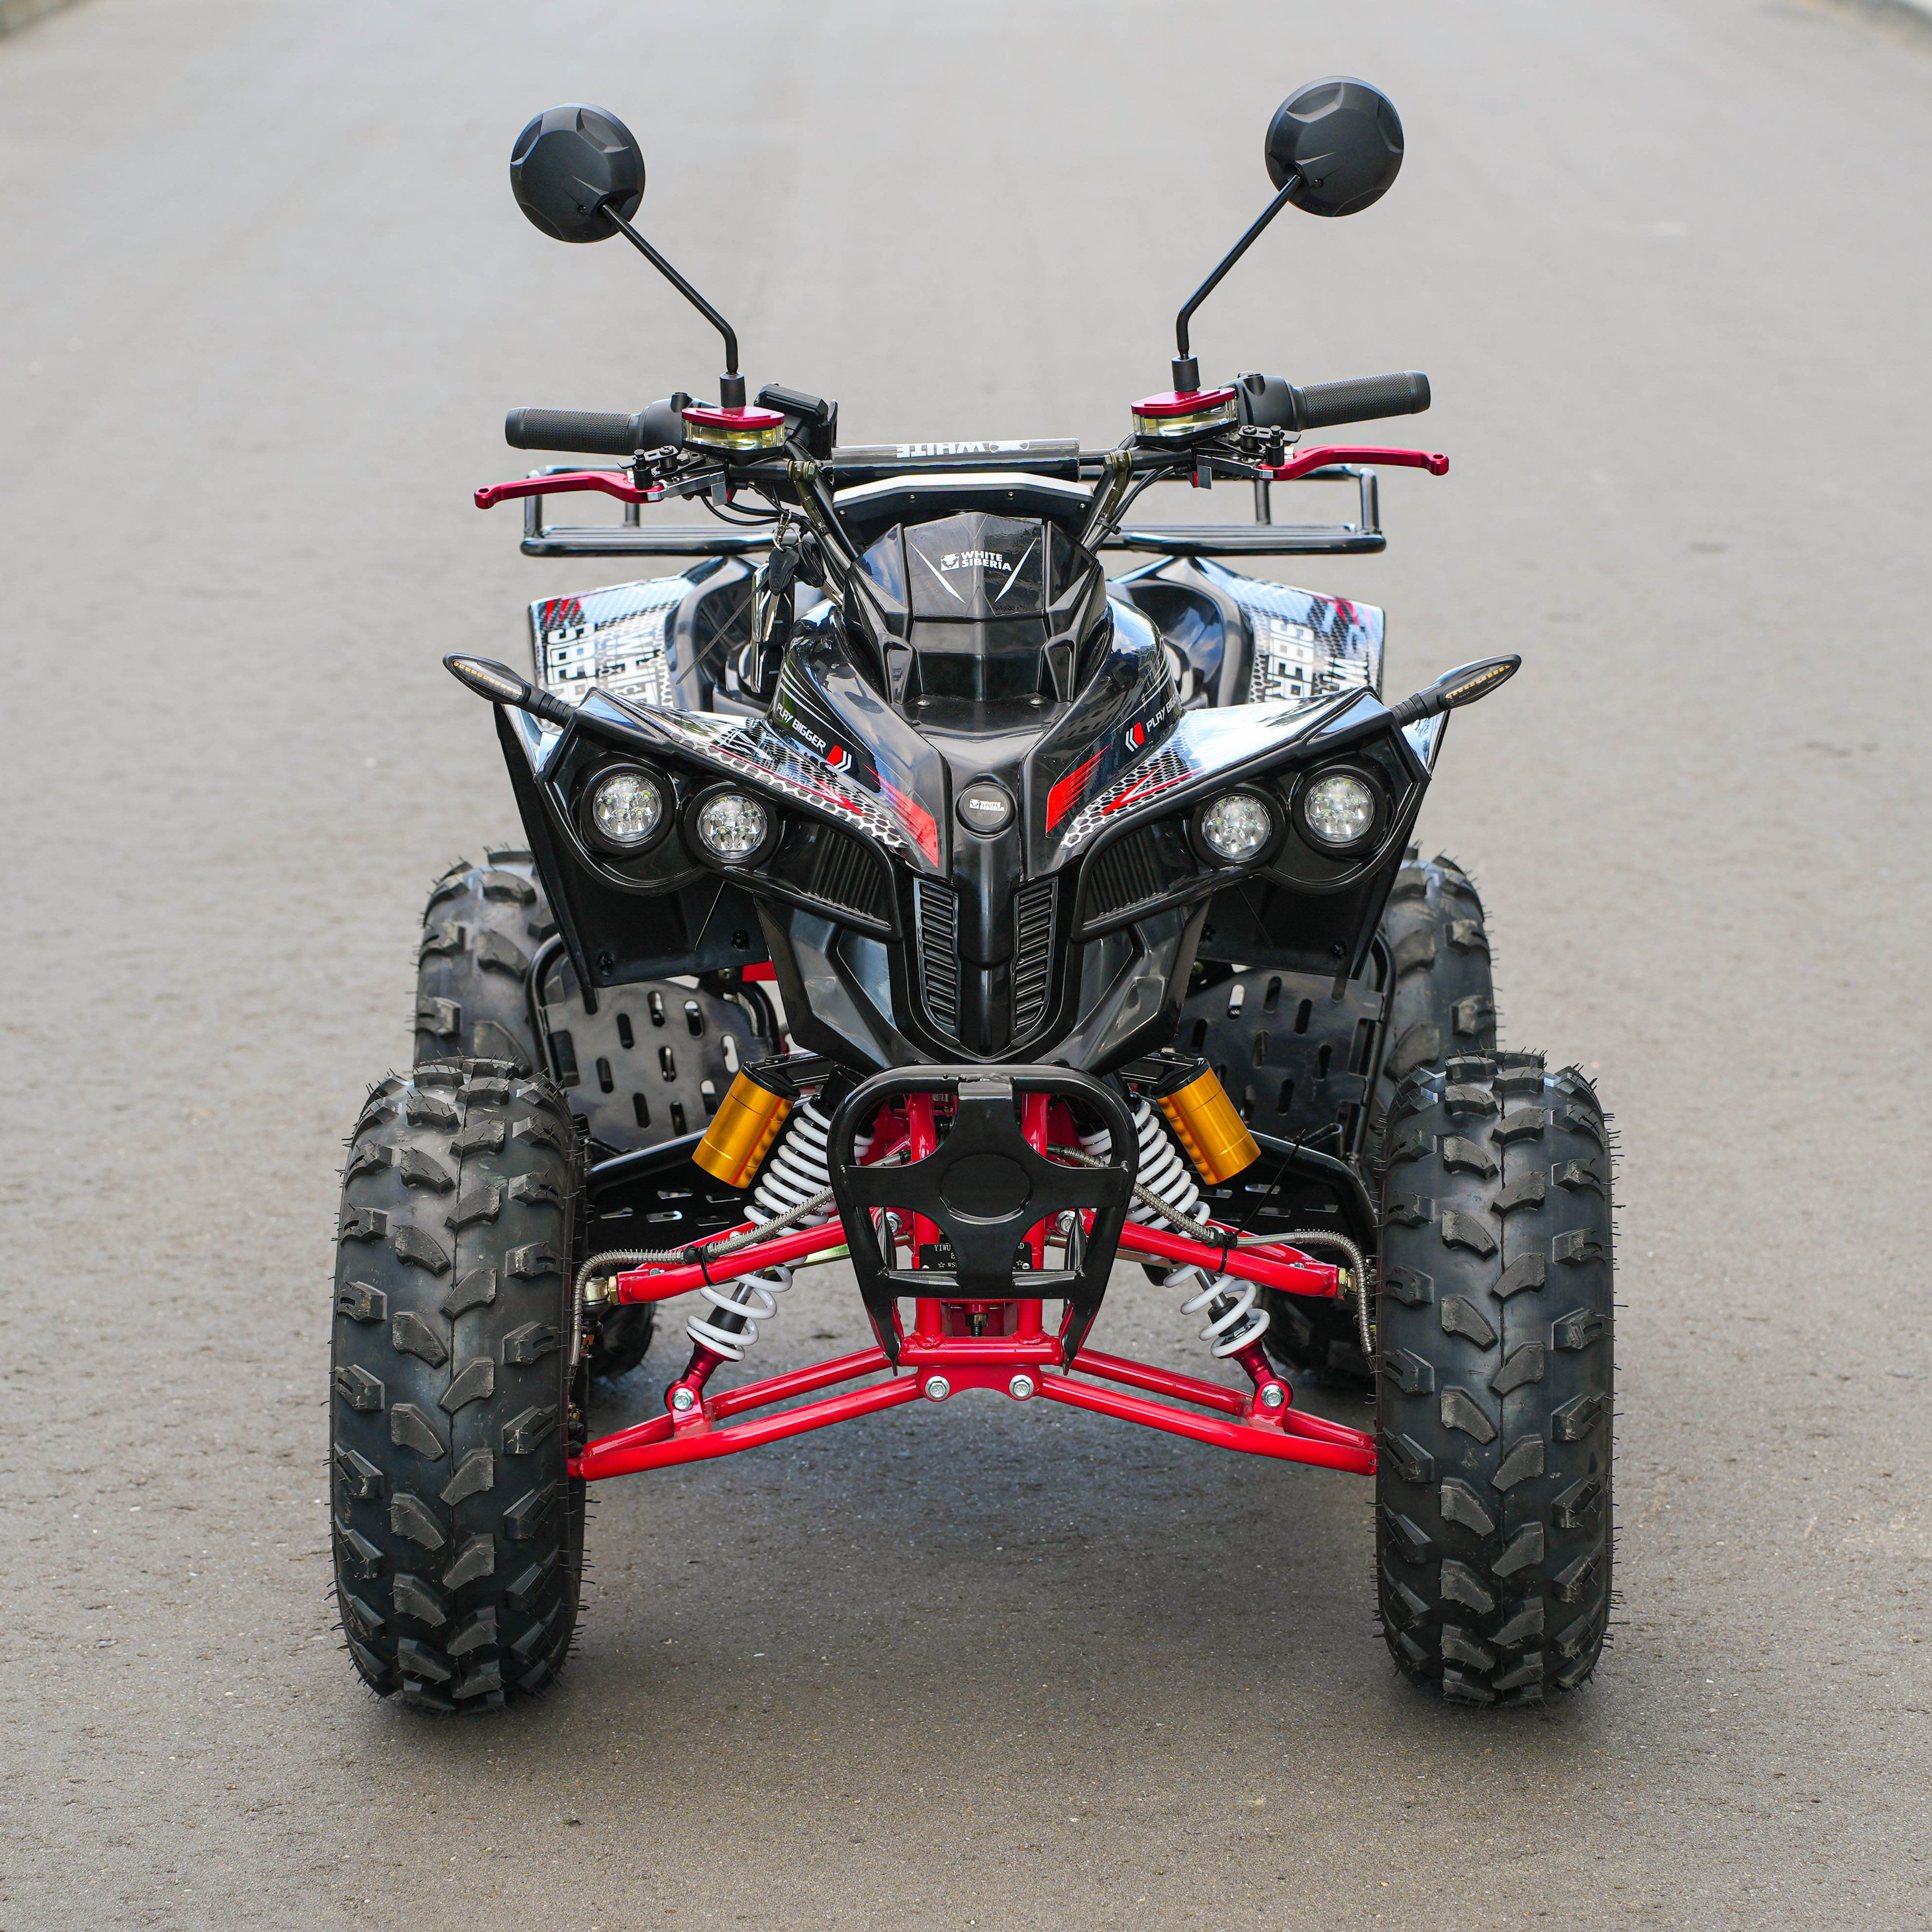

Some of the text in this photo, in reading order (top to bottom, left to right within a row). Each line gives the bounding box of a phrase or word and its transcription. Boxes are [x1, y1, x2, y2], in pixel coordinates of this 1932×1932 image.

[961, 550, 1003, 562] WHITE
[961, 558, 1012, 572] SIBERIA
[547, 623, 597, 704] SIBER
[606, 628, 659, 705] WHIT
[1265, 619, 1314, 701] SIBER
[776, 702, 826, 755] PLAY BIGGER
[1146, 706, 1165, 732] PLAY
